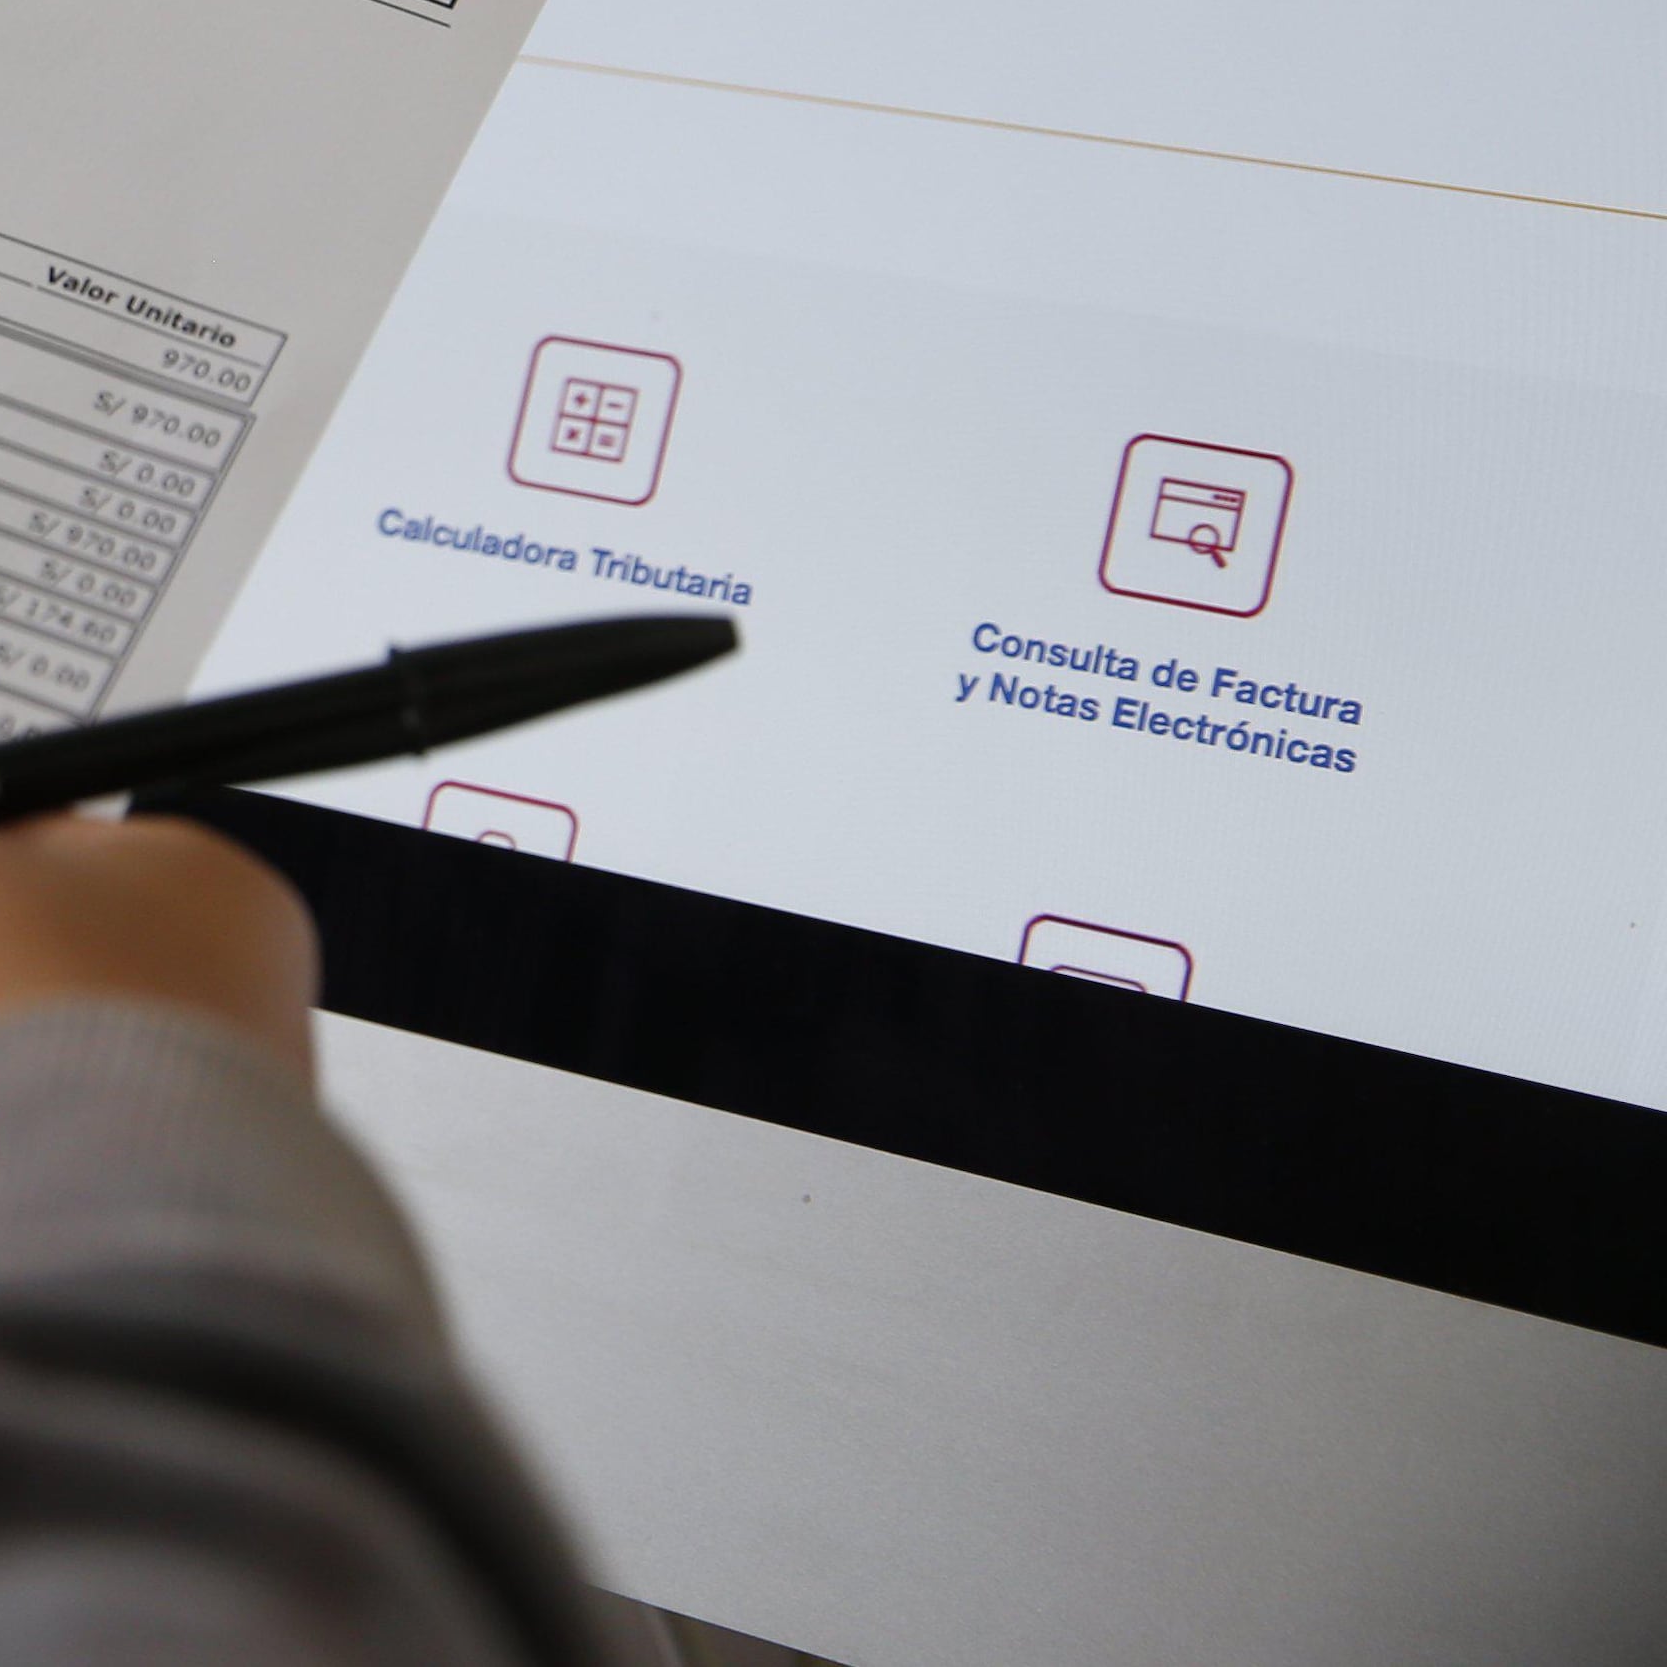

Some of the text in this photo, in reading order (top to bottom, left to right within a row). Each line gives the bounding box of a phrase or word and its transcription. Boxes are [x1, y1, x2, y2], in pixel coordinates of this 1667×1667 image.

[47, 265, 119, 305] Valor
[125, 294, 238, 348] Unitario
[162, 350, 252, 392] 970.00
[376, 507, 755, 608] Calculadora Tributaria
[954, 671, 1361, 776] y Notas Electrónicas
[970, 621, 1365, 728] Consulta de Factura
